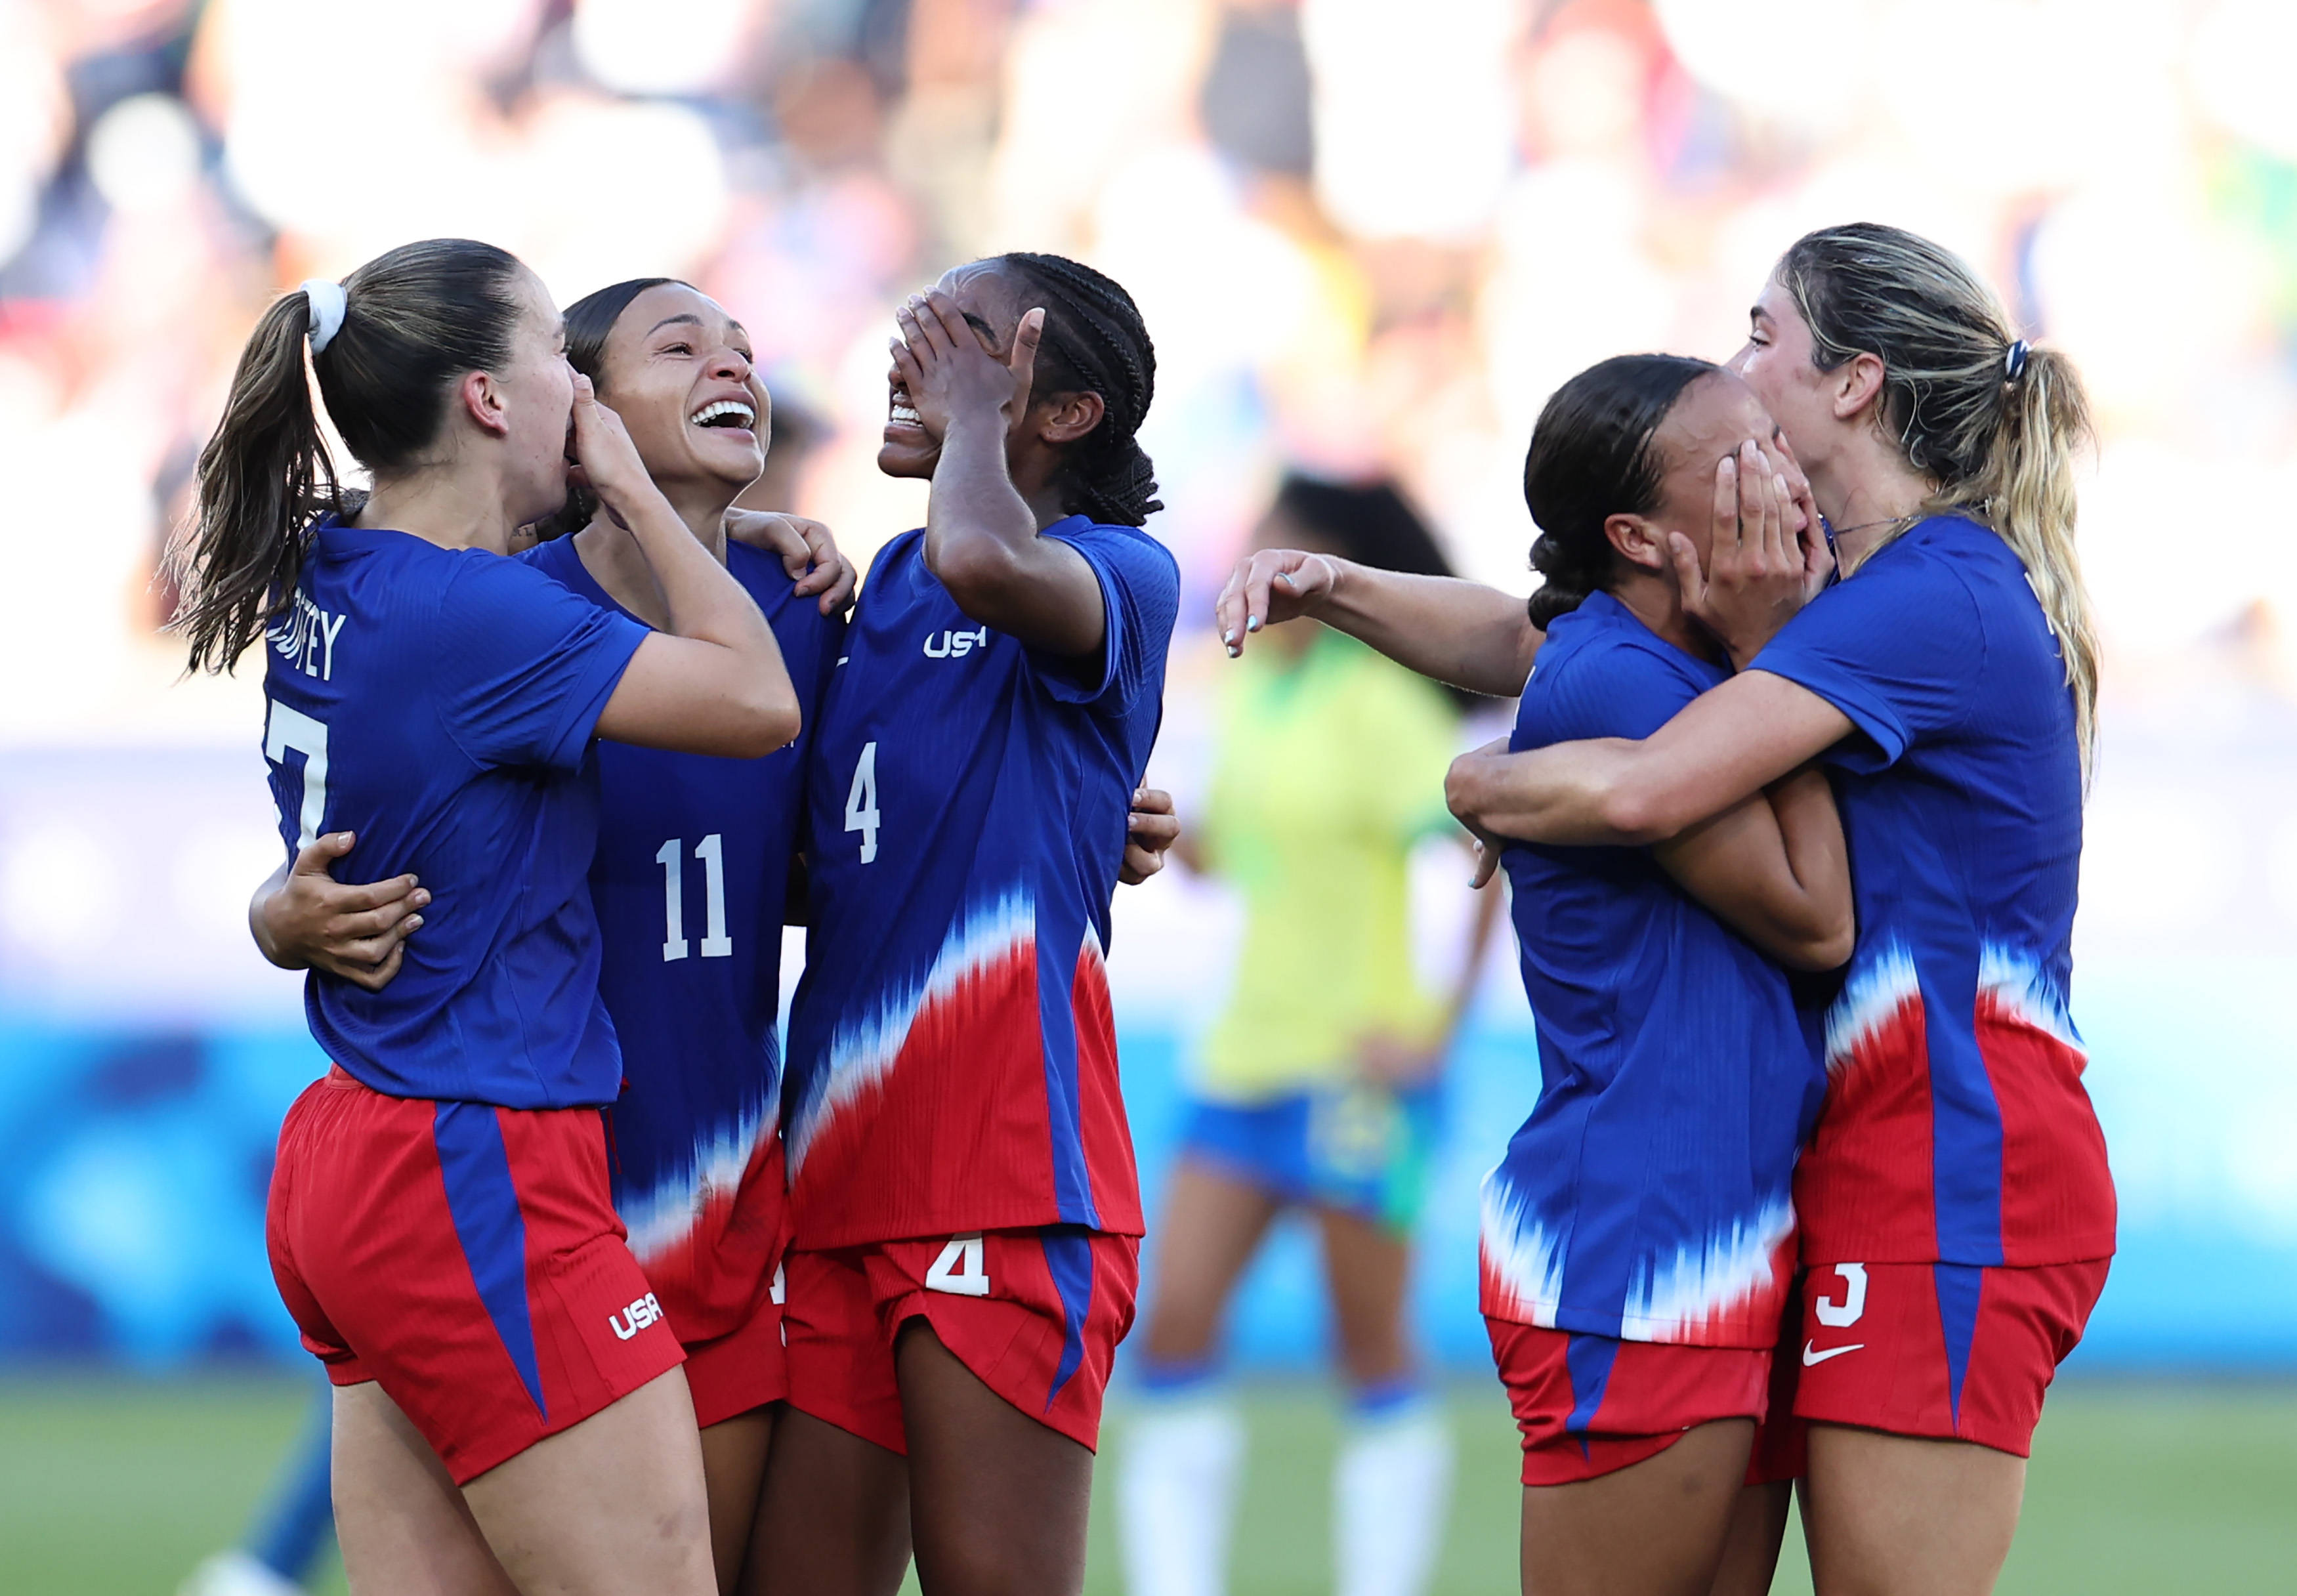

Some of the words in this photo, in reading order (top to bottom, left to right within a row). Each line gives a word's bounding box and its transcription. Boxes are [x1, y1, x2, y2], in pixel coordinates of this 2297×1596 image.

[266, 698, 328, 850] 7
[845, 742, 880, 864] 4
[656, 833, 732, 962] 11
[608, 1292, 664, 1340] USA
[925, 1230, 990, 1297] 4
